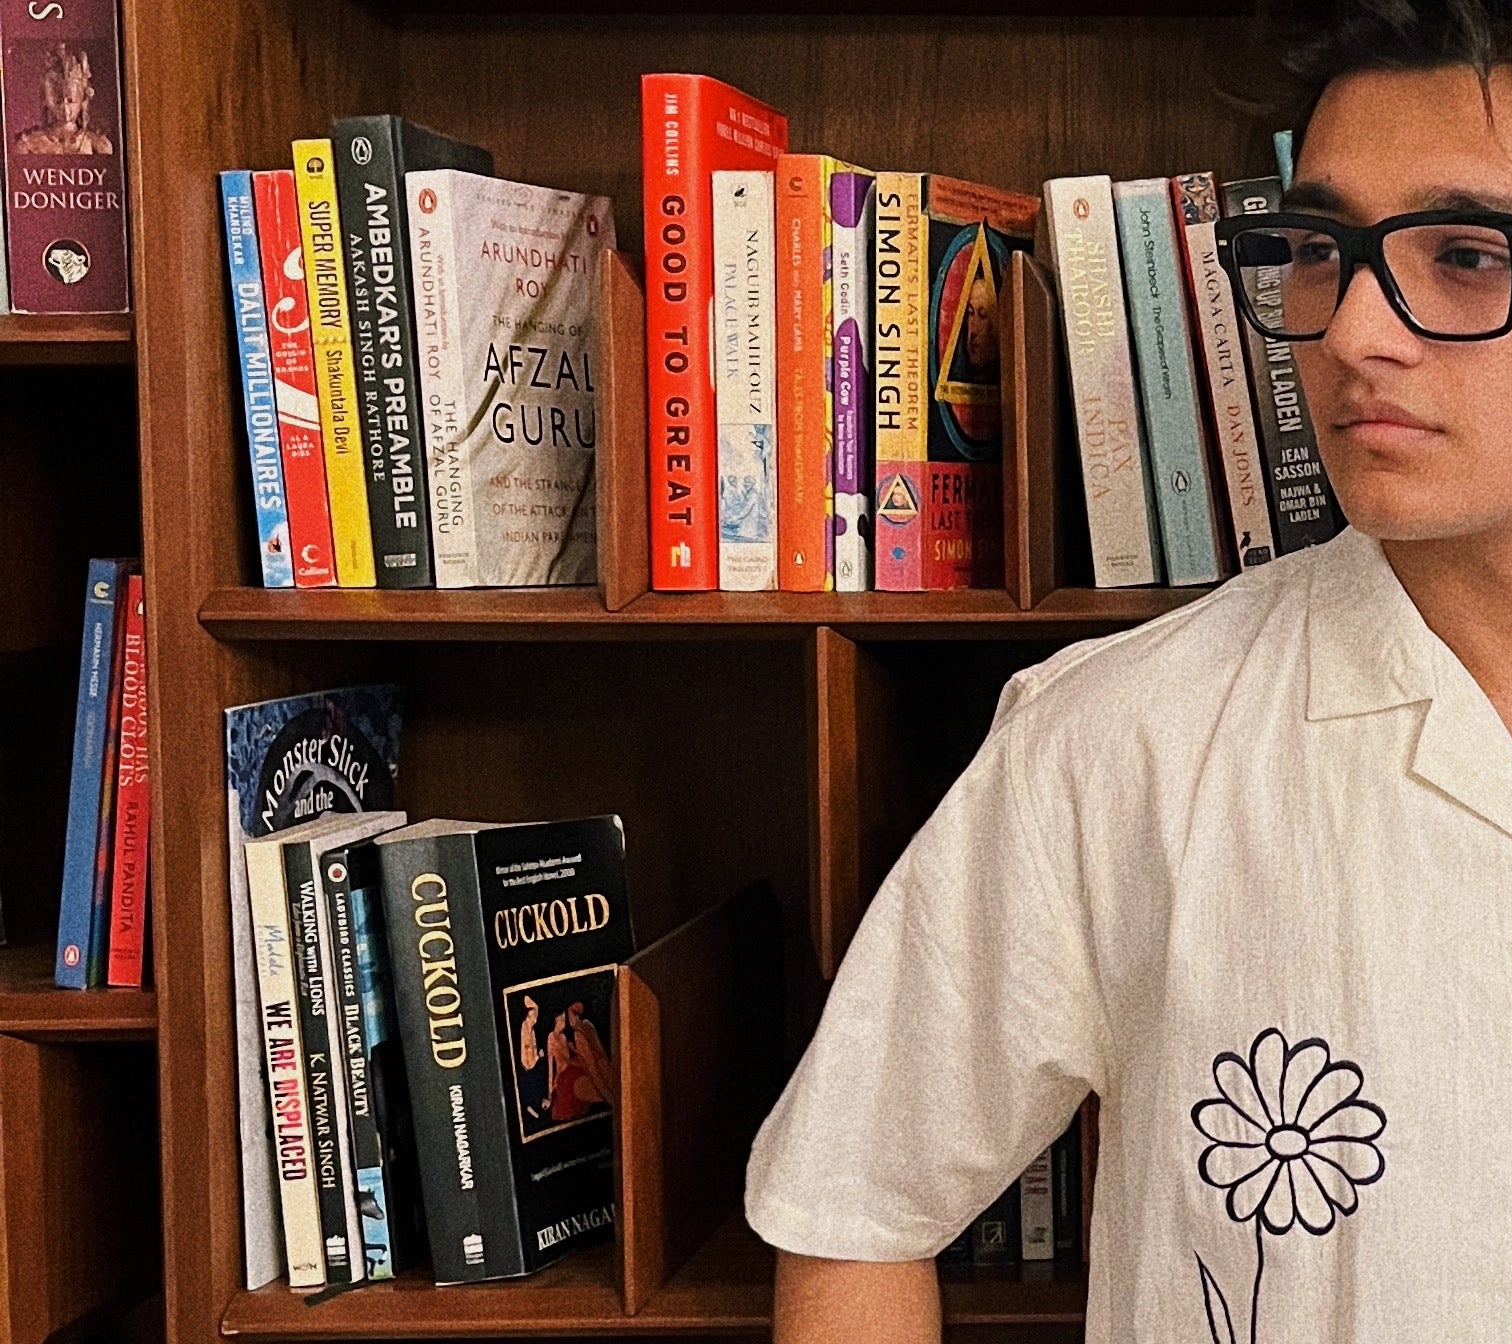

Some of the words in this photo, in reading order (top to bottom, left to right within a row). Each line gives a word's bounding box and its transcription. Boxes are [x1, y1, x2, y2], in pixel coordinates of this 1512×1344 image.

[14, 191, 119, 210] DONIGER
[23, 168, 106, 187] WENDY
[308, 200, 332, 256] SUPER
[480, 241, 587, 273] ARUNDHATI
[661, 194, 687, 302] GOOD
[878, 193, 900, 305] SIMON
[313, 259, 343, 328] MEMORY
[349, 233, 369, 313] AAKASH
[515, 279, 550, 298] ROY
[841, 252, 849, 279] Seth
[236, 283, 268, 346] DALIT
[418, 227, 440, 344] ARUNDHATI
[429, 345, 440, 382] ROY
[841, 282, 850, 316] Godin
[1202, 251, 1221, 323] MAGNA
[1212, 325, 1232, 388] CARTA
[358, 320, 376, 383] SINGH
[363, 182, 404, 369] AMBEDKAR'S
[384, 377, 417, 529] PREAMBLE
[664, 327, 689, 375] TO
[878, 323, 900, 431] SINGH
[326, 350, 347, 424] Shakuntala
[1272, 369, 1302, 433] LADEN
[245, 352, 281, 512] MILLIONAIRES
[336, 427, 348, 454] Devi
[365, 391, 384, 482] RATHORE
[1227, 405, 1242, 441] DAN
[1281, 448, 1309, 461] JEAN
[667, 398, 692, 527] GREAT
[1233, 445, 1253, 507] JONES
[1274, 462, 1320, 479] SASSON
[123, 633, 142, 708] BLOOD
[119, 714, 136, 788] CLOTS
[495, 894, 610, 949] CUCKOLD
[412, 873, 466, 1068] CUCKOLD
[266, 1001, 292, 1031] WE
[269, 1039, 297, 1073] ARE
[274, 1079, 308, 1181] DISPLACED
[450, 1085, 464, 1121] KIRAN
[454, 1125, 473, 1190] NAGARKAR
